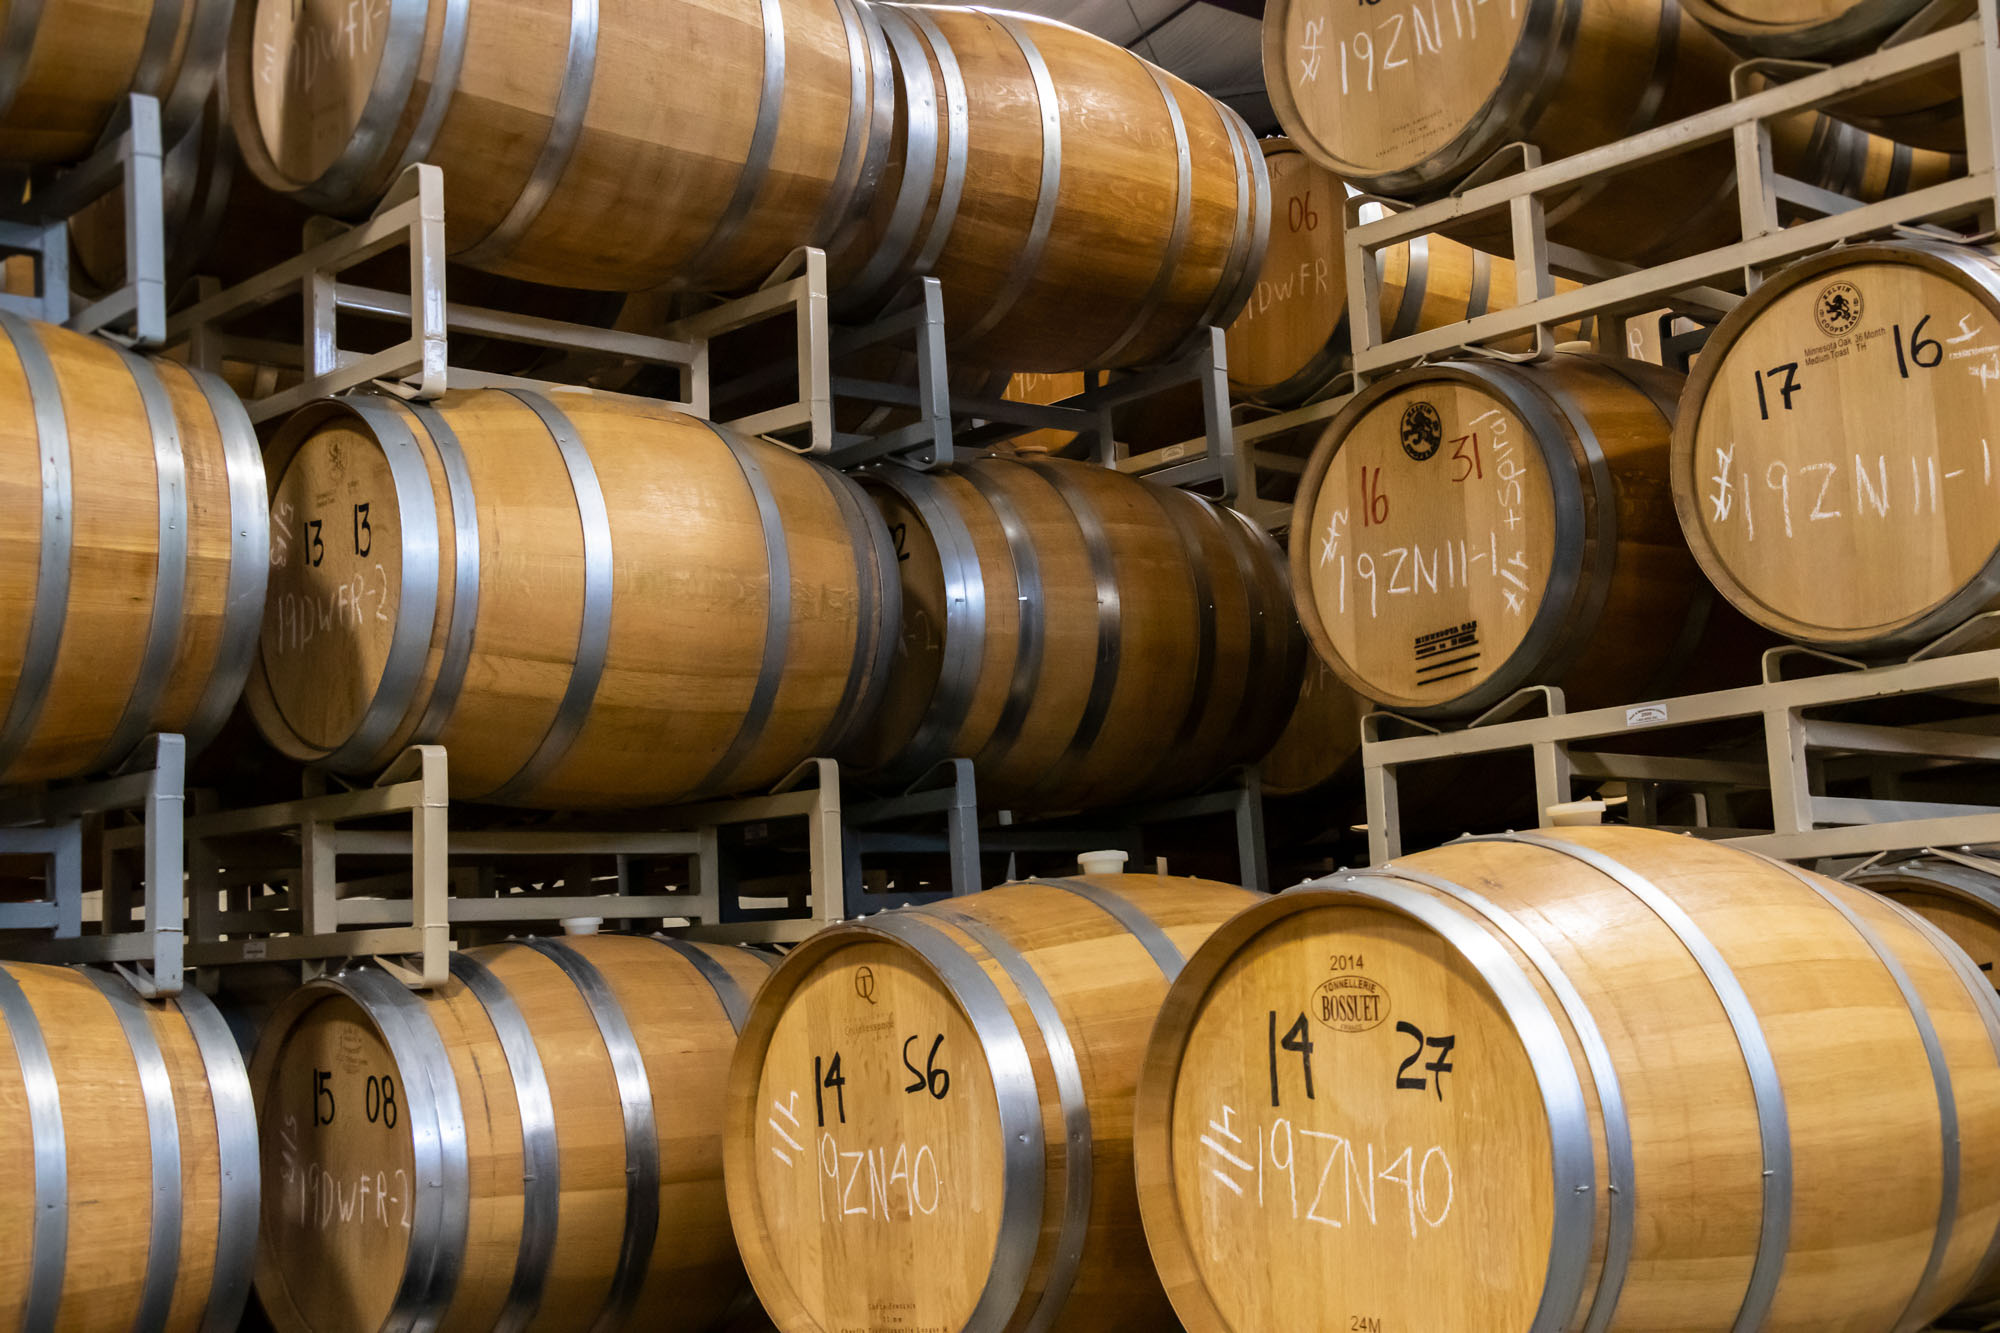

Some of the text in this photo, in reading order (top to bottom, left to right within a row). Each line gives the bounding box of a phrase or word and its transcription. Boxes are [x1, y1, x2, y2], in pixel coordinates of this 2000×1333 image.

[1288, 191, 1318, 233] 06
[1240, 257, 1329, 322] DWFR
[1823, 285, 1851, 300] KELVIN
[1804, 342, 1837, 357] Minnesota
[1838, 337, 1852, 348] Oak
[1863, 327, 1886, 340] Month
[1821, 310, 1859, 333] COOPERAGE
[1755, 314, 1943, 421] 17 16
[1804, 353, 1830, 366] Medium
[1830, 348, 1850, 360] Toast
[1361, 466, 1389, 528] 16
[1449, 432, 1483, 483] 31
[304, 503, 372, 568] 13 13
[277, 564, 388, 655] 19DWFR-2
[1323, 979, 1377, 993] TONNELLERIE
[1330, 954, 1364, 971] 2014
[1322, 995, 1380, 1021] BOSSUET
[815, 1051, 845, 1127] 14
[1269, 1010, 1455, 1107] 14 27
[313, 1068, 397, 1129] 15 08
[301, 1162, 411, 1230] 19DWFR-2
[817, 1132, 939, 1223] 19ZN40
[1258, 1117, 1453, 1240] 19ZN40
[1350, 1315, 1381, 1333] 24M
